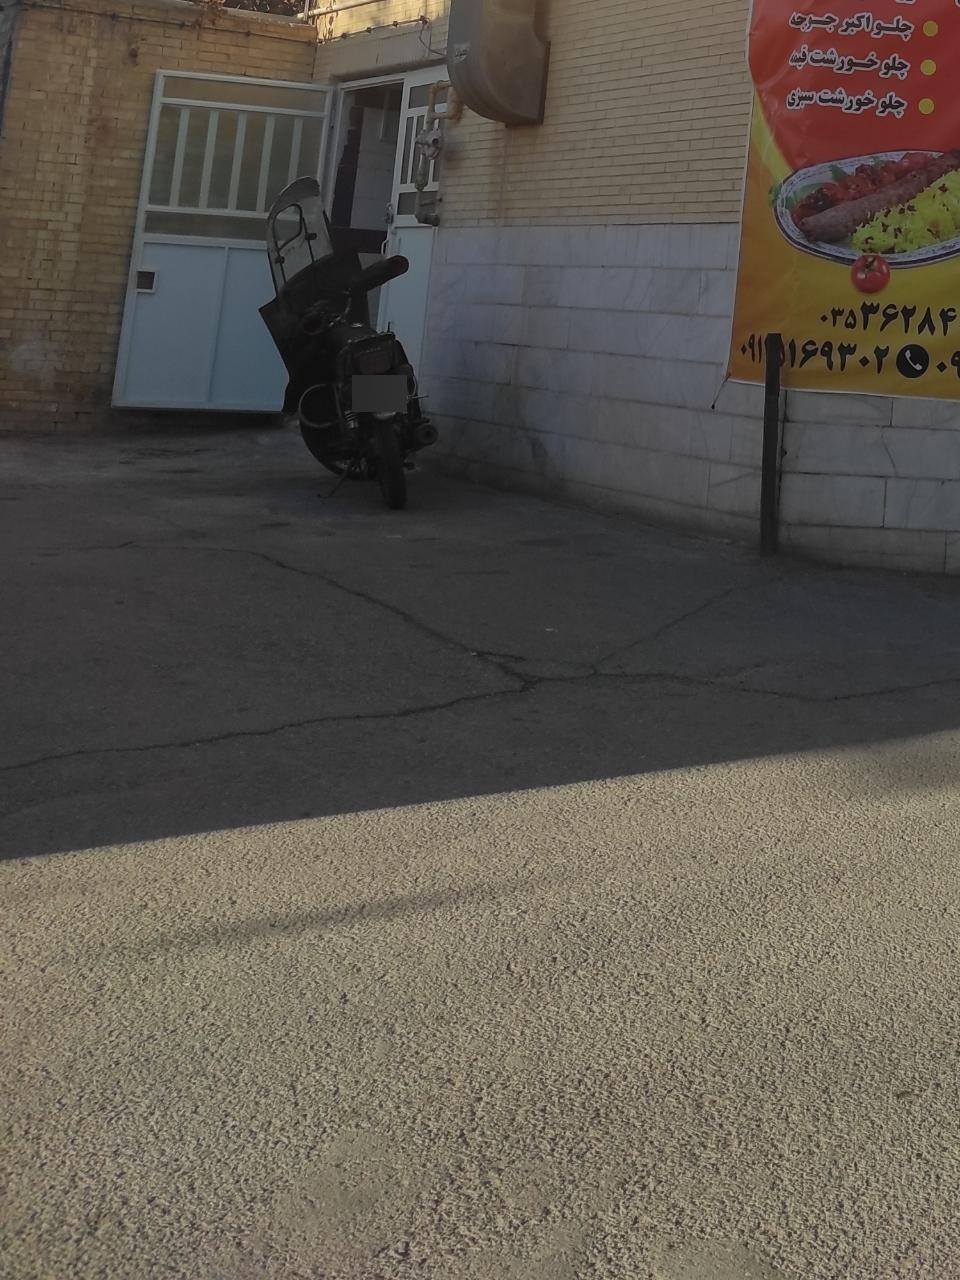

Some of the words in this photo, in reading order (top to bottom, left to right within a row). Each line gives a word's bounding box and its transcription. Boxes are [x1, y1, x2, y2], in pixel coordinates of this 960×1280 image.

[838, 12, 873, 34] اکبر
[871, 15, 914, 41] چلو
[808, 48, 881, 75] خورشت
[879, 53, 911, 80] چلو
[786, 87, 815, 110] سبزی
[817, 87, 877, 114] خورشت
[876, 91, 908, 119] چلو
[740, 333, 890, 375] ۰۹۱۱۶۹۳۰۲
